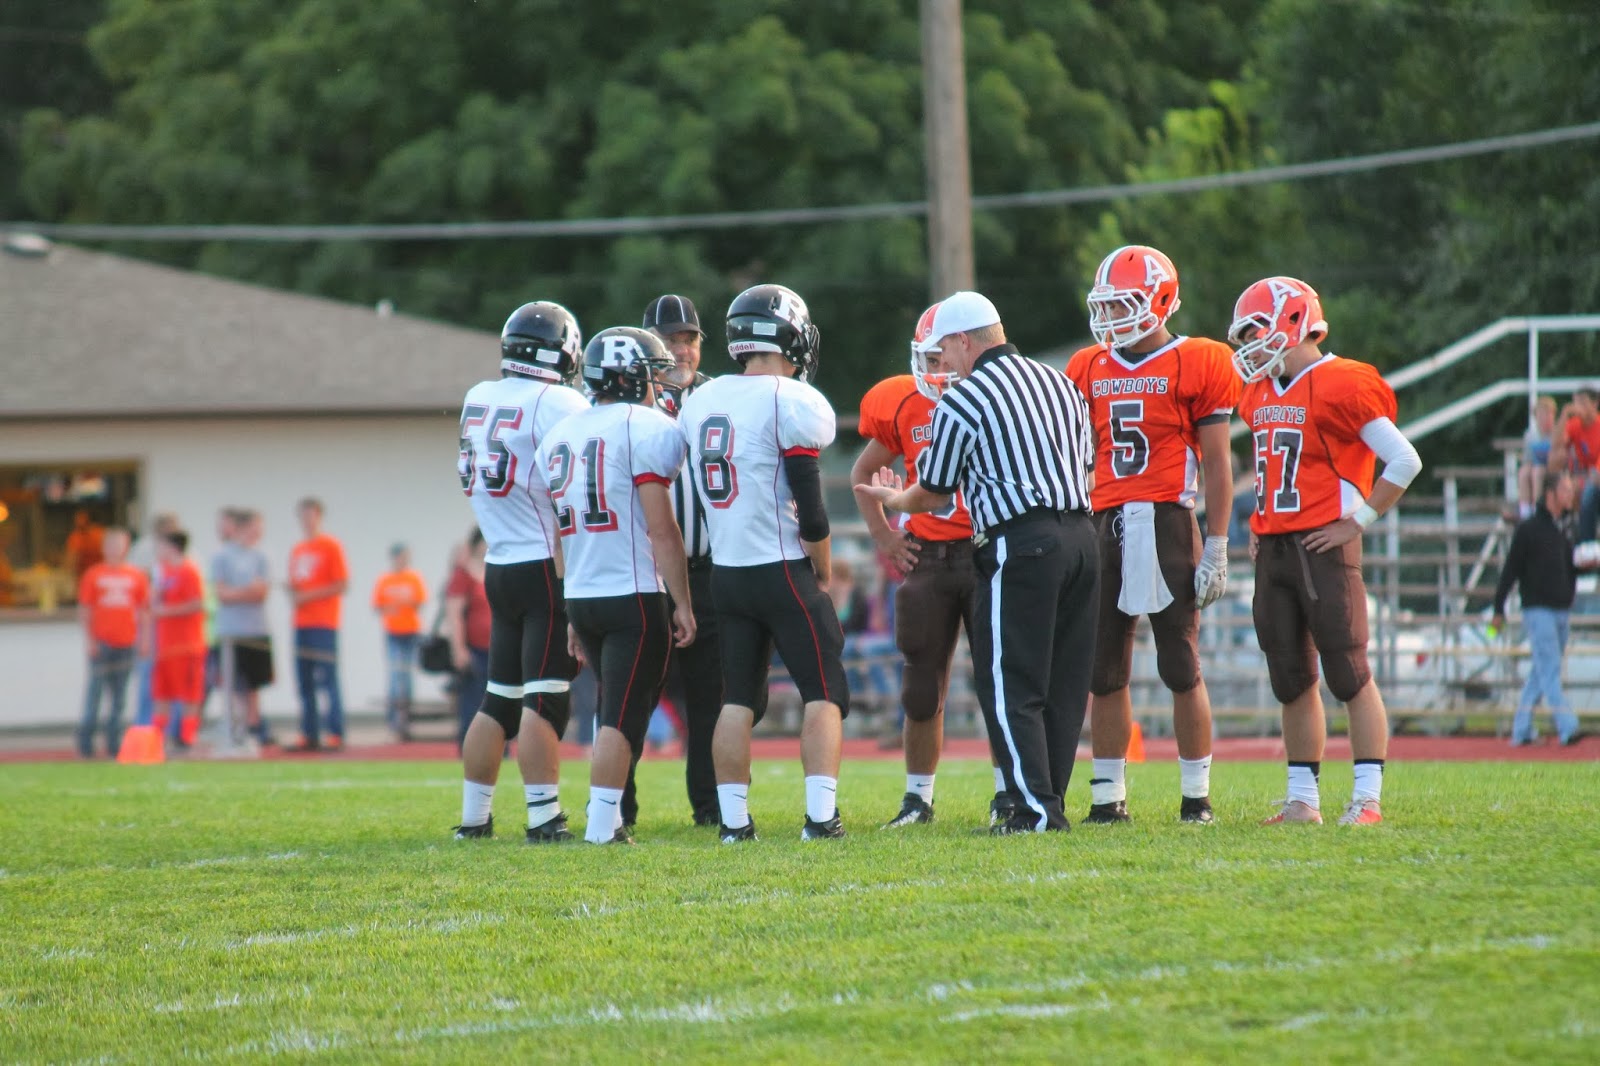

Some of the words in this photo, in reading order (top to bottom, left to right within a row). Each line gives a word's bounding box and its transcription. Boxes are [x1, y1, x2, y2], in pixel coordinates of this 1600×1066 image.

[1143, 254, 1171, 287] A
[510, 362, 543, 376] Riddell
[600, 335, 640, 368] R
[1092, 376, 1169, 398] COWBOYS
[1109, 399, 1150, 480] 5
[1253, 405, 1306, 427] COWBOYS
[458, 402, 524, 498] 55
[698, 413, 740, 510] 8
[1253, 427, 1304, 516] 57
[548, 436, 619, 538] 21
